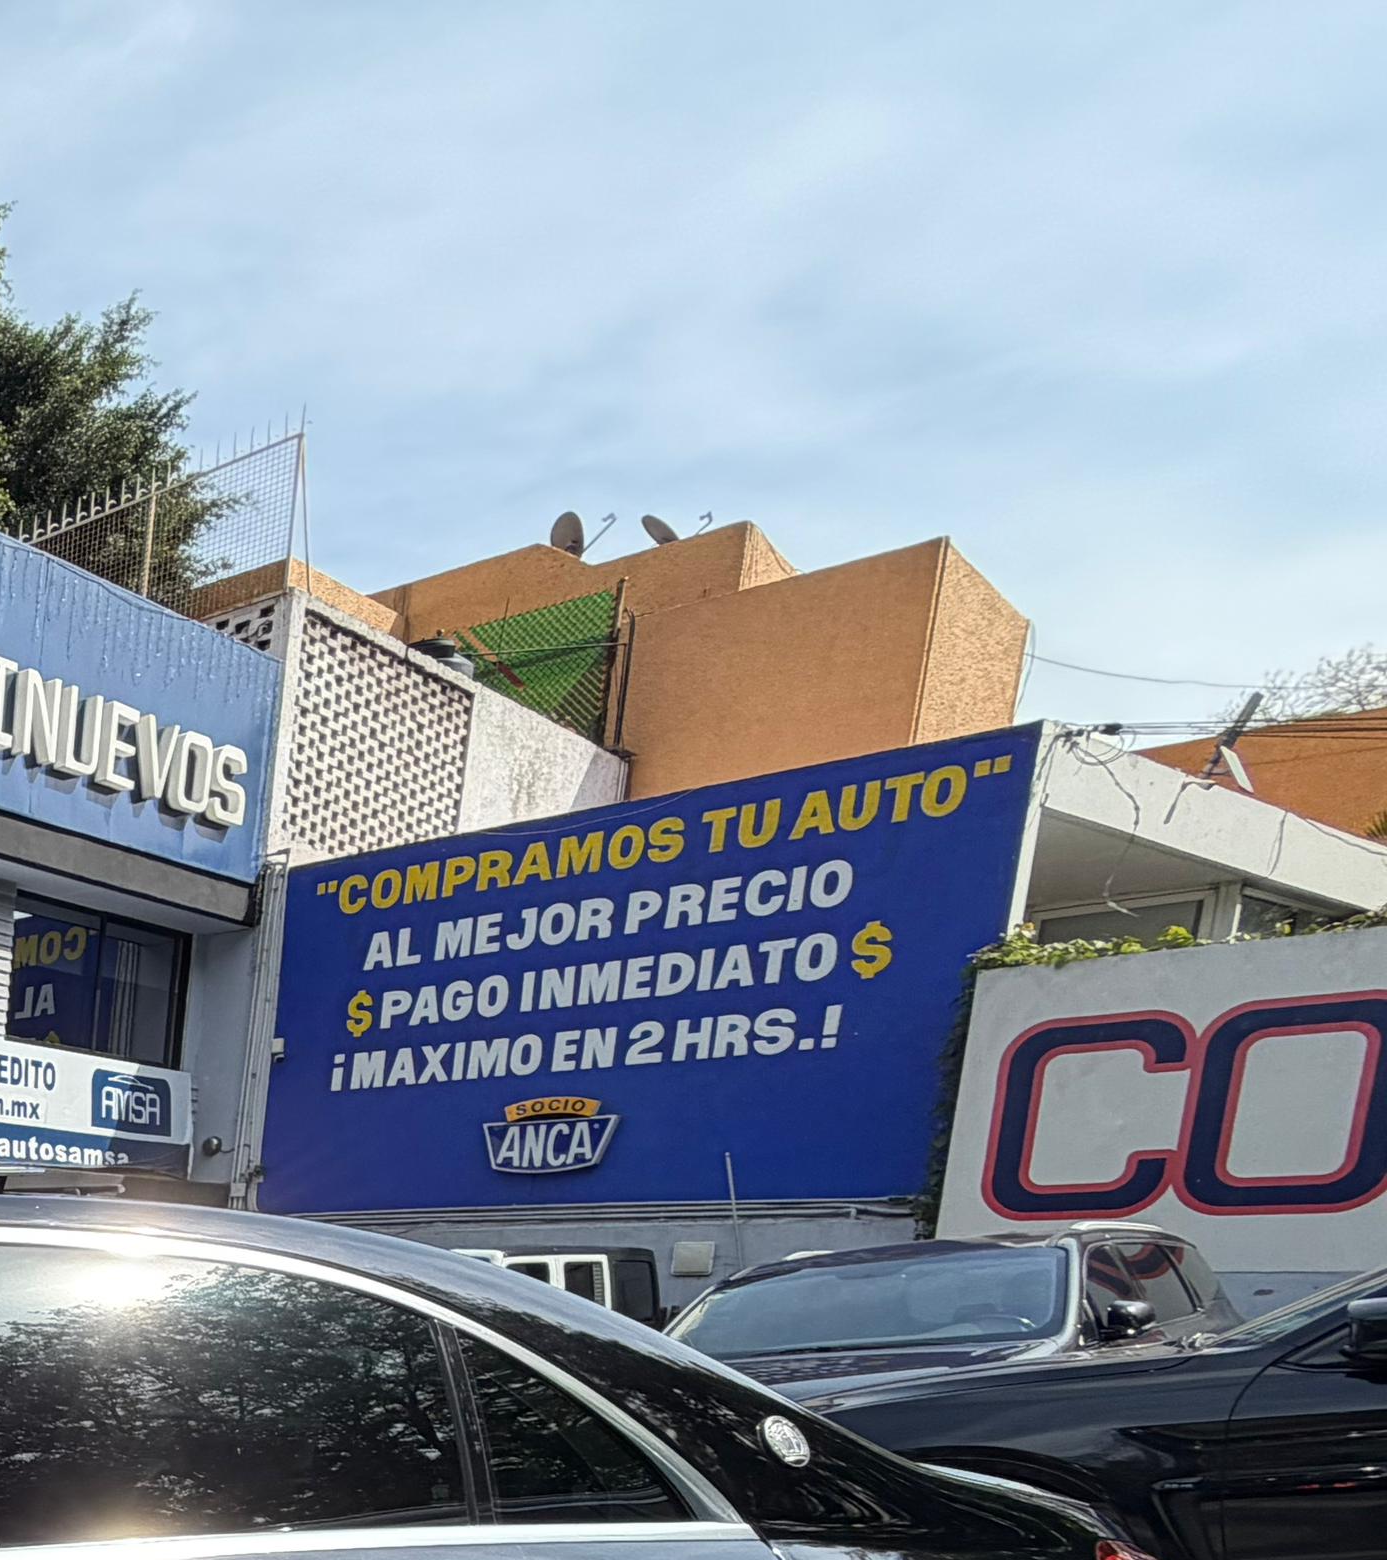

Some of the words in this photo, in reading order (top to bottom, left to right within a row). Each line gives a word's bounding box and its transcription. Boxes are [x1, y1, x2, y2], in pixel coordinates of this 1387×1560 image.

[702, 798, 781, 853] TU
[363, 927, 421, 971] AL
[434, 897, 615, 961] MEJOR
[624, 859, 853, 934] PRECIO
[520, 933, 838, 1012] INMEDIATO
[551, 1027, 617, 1072] EN
[625, 1020, 665, 1066] 2
[102, 1086, 160, 1125] AMSA
[516, 1100, 586, 1116] SOCIO
[496, 1121, 593, 1168] ANCA
